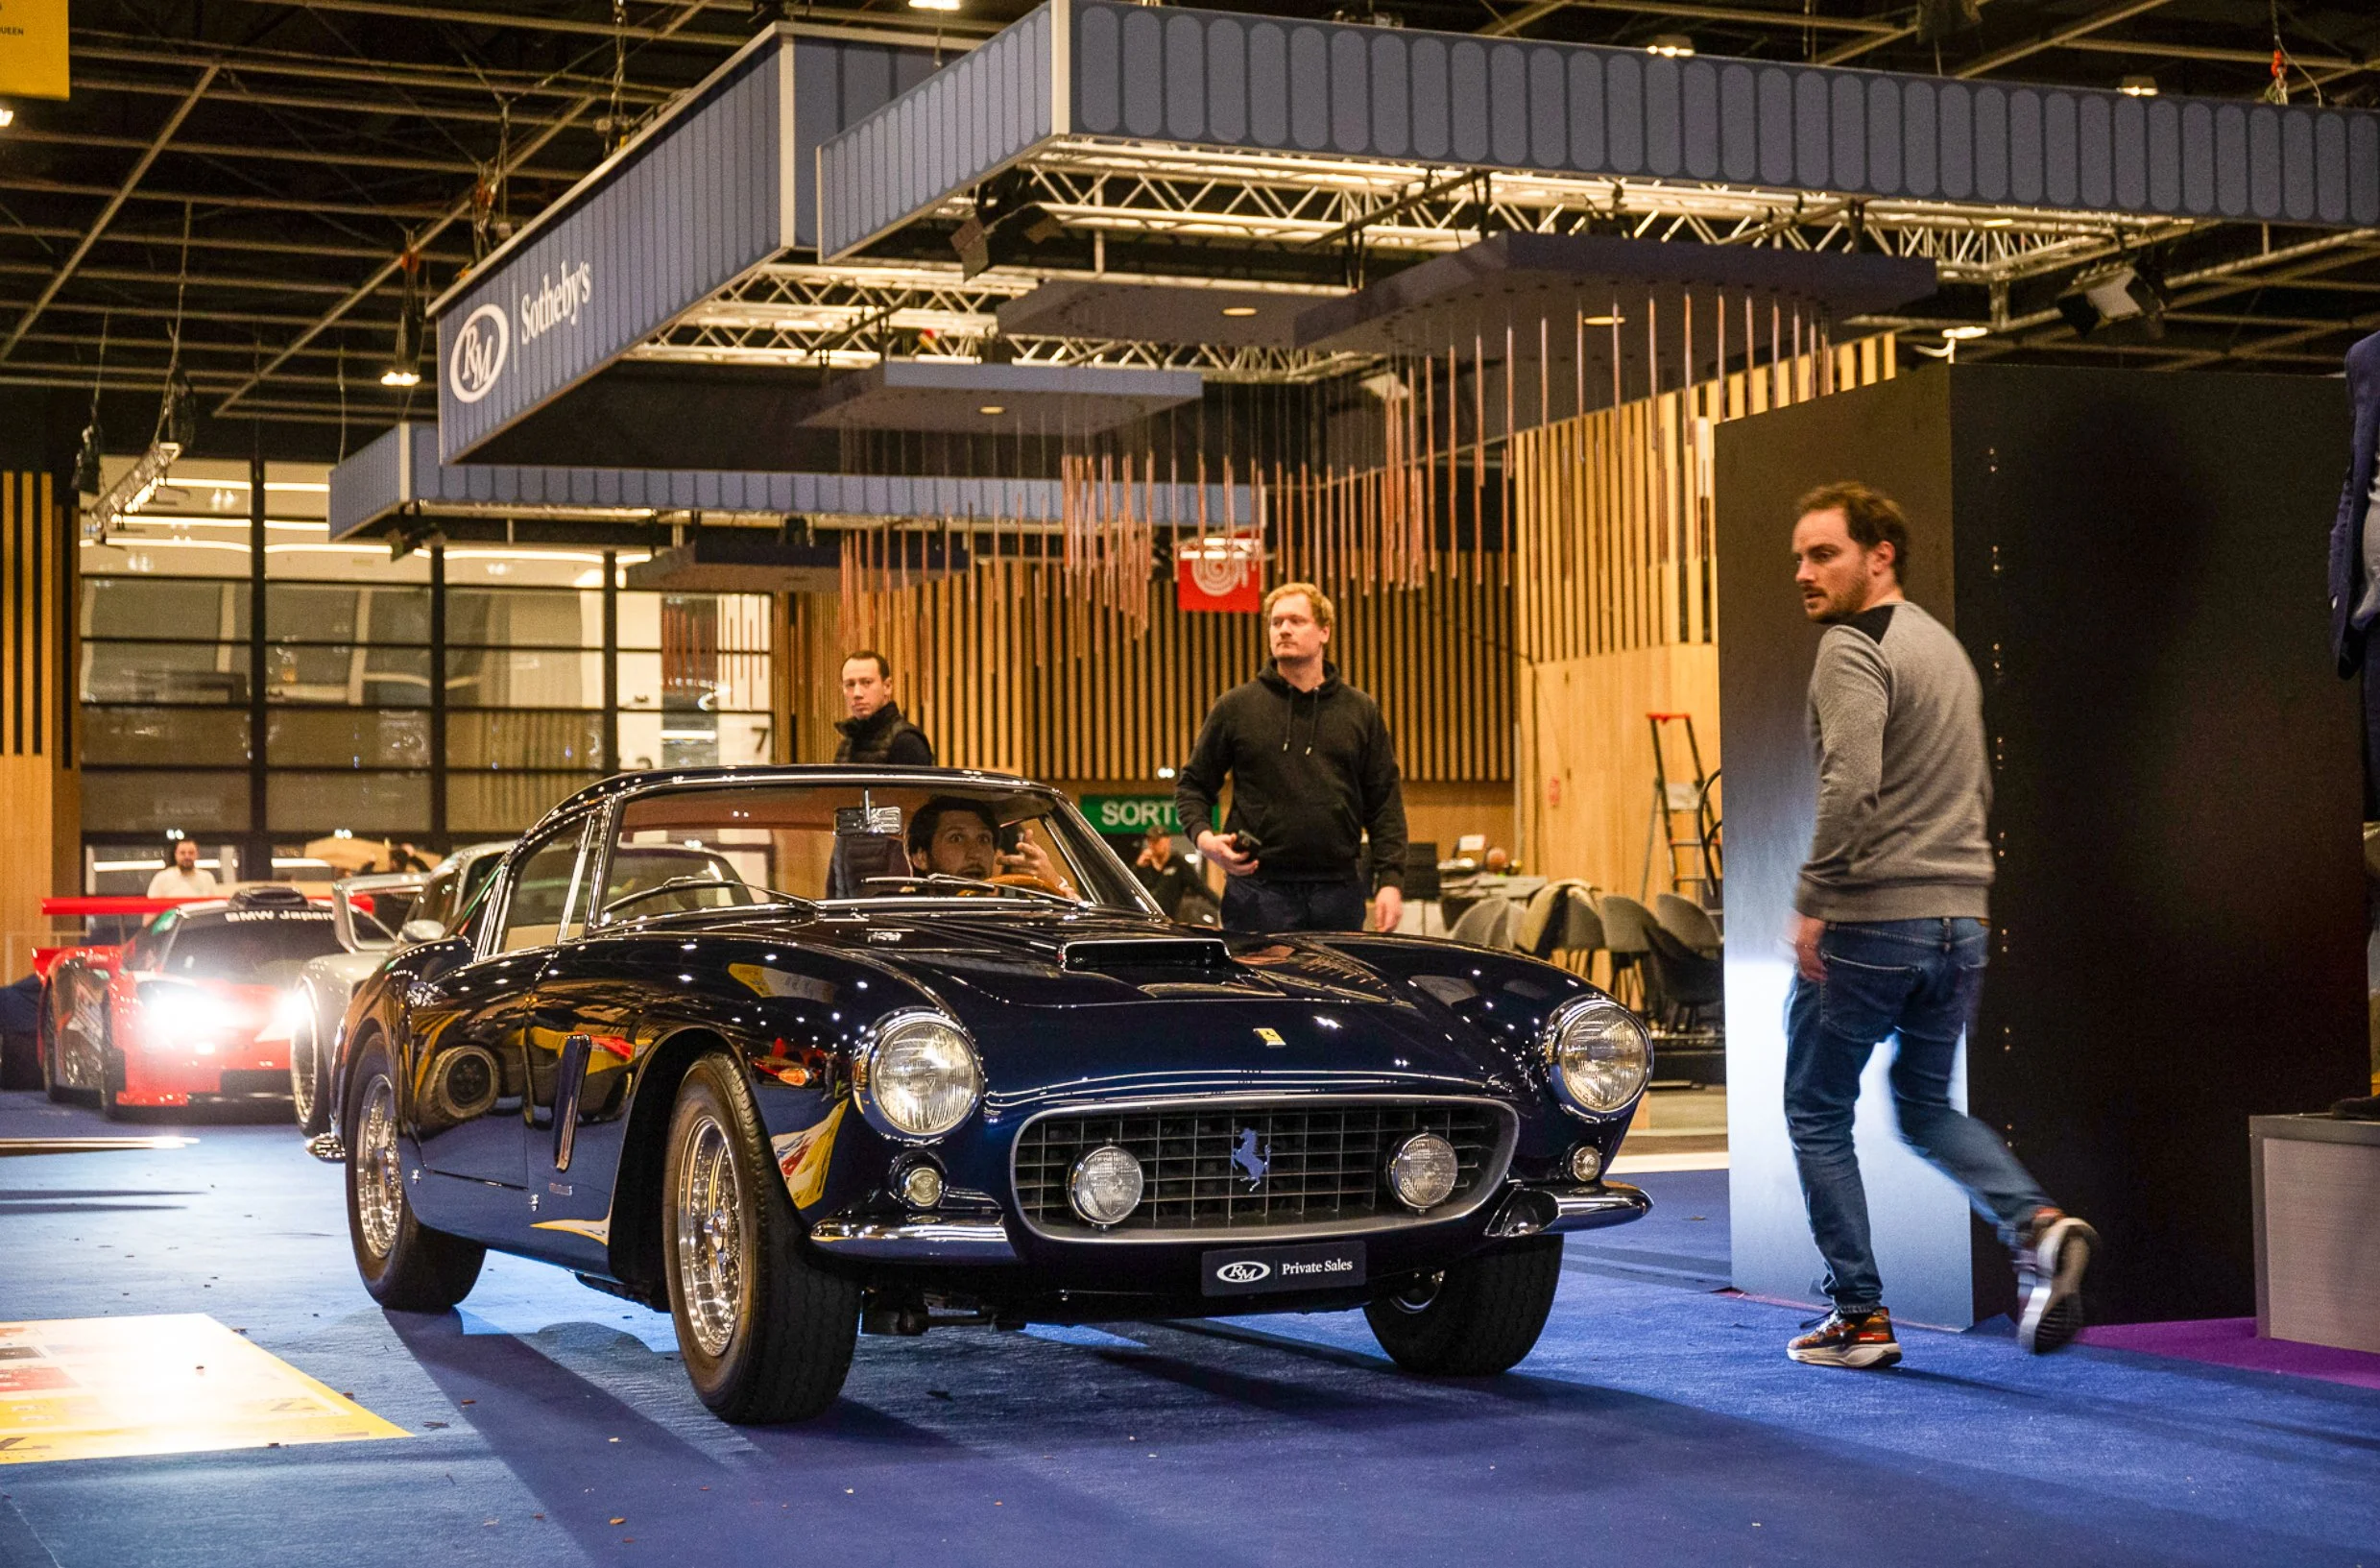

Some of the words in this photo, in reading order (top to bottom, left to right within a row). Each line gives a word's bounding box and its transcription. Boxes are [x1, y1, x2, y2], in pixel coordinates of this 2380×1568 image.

[0, 26, 24, 36] UEEN
[521, 259, 592, 346] Sotheby's
[1101, 801, 1182, 826] SORT
[225, 910, 275, 922] BMW
[279, 910, 335, 921] Japan
[1282, 1262, 1322, 1275] Private
[1324, 1258, 1353, 1272] Sales
